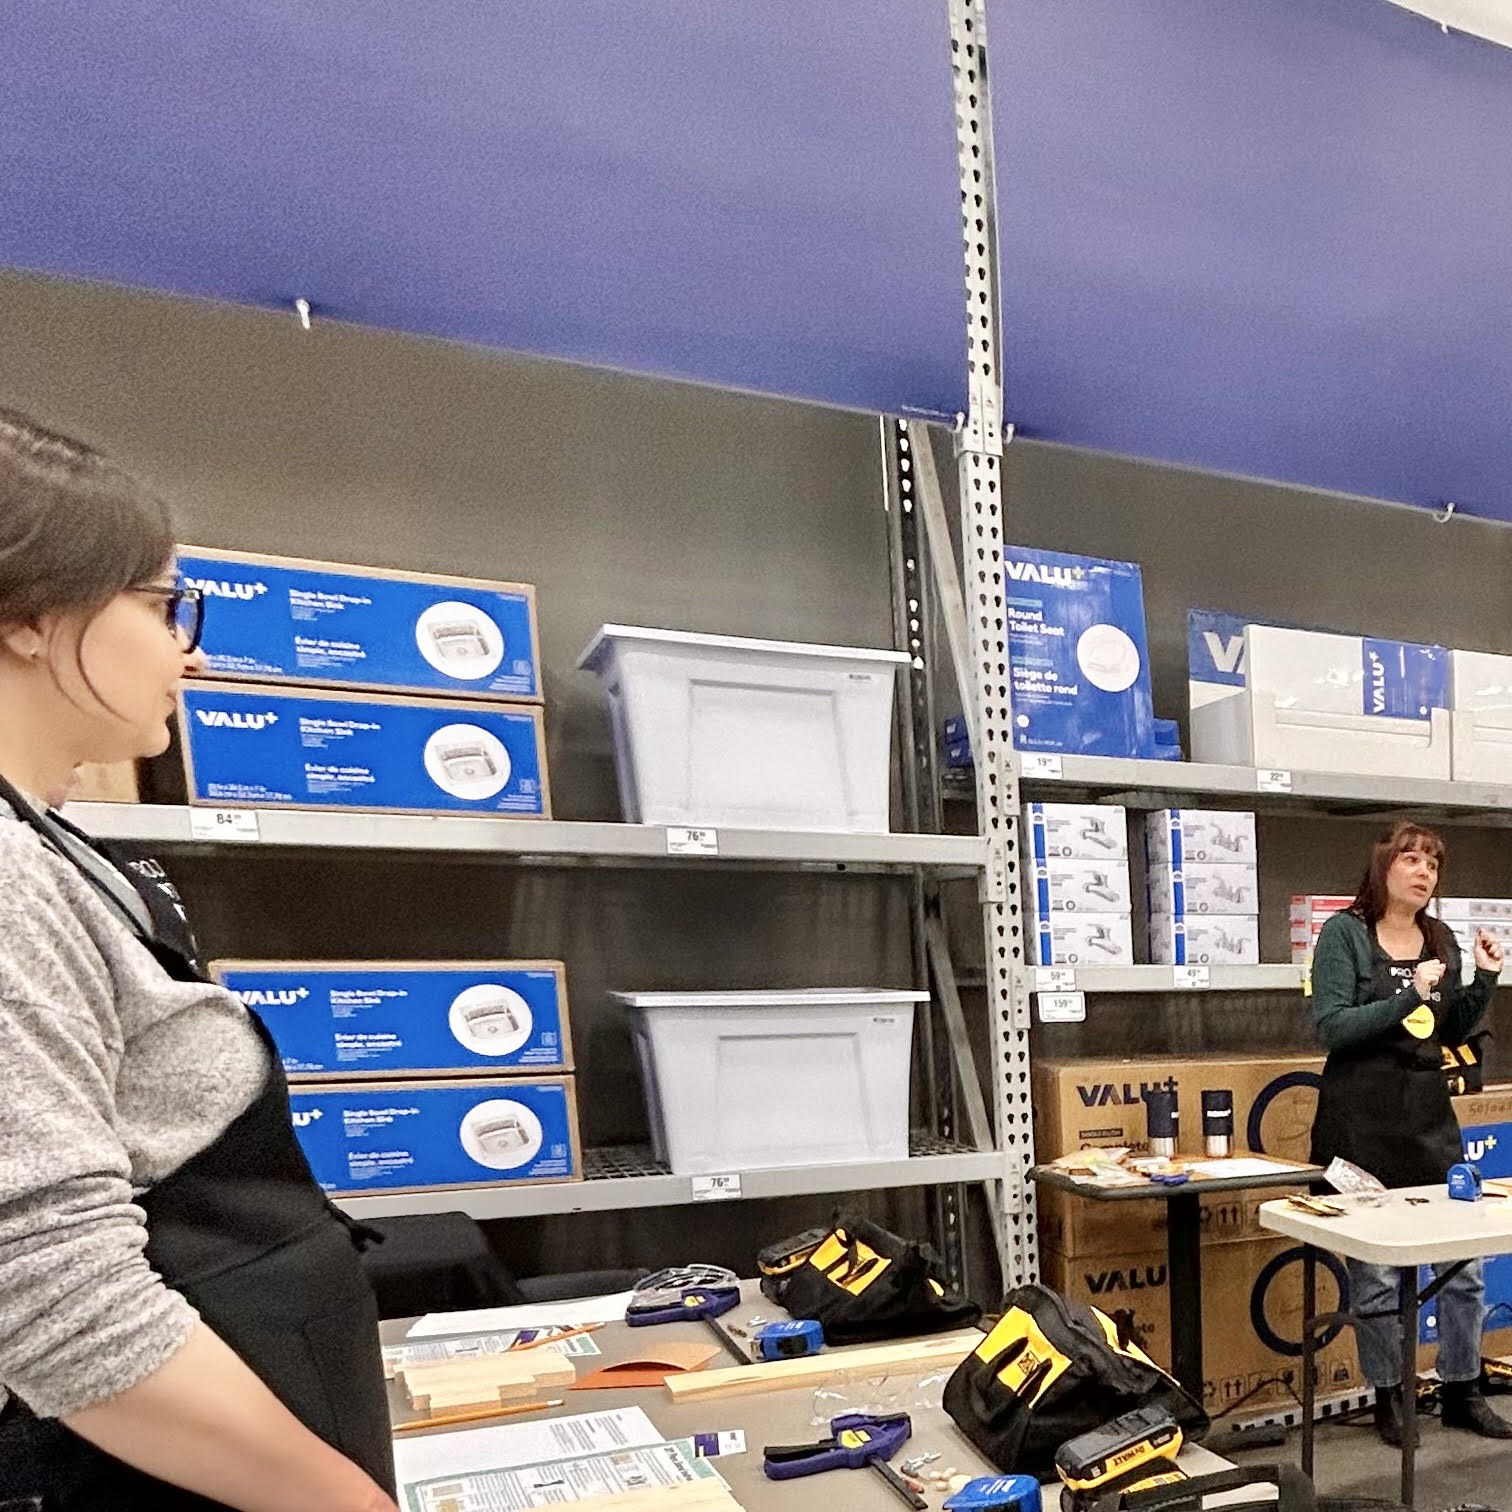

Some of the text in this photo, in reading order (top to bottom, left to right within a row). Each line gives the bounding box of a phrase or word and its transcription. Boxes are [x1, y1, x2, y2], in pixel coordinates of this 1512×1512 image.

[1008, 608, 1043, 621] Round
[1009, 621, 1065, 636] Toilet Seat
[1044, 670, 1058, 681] de
[1054, 685, 1078, 695] rond
